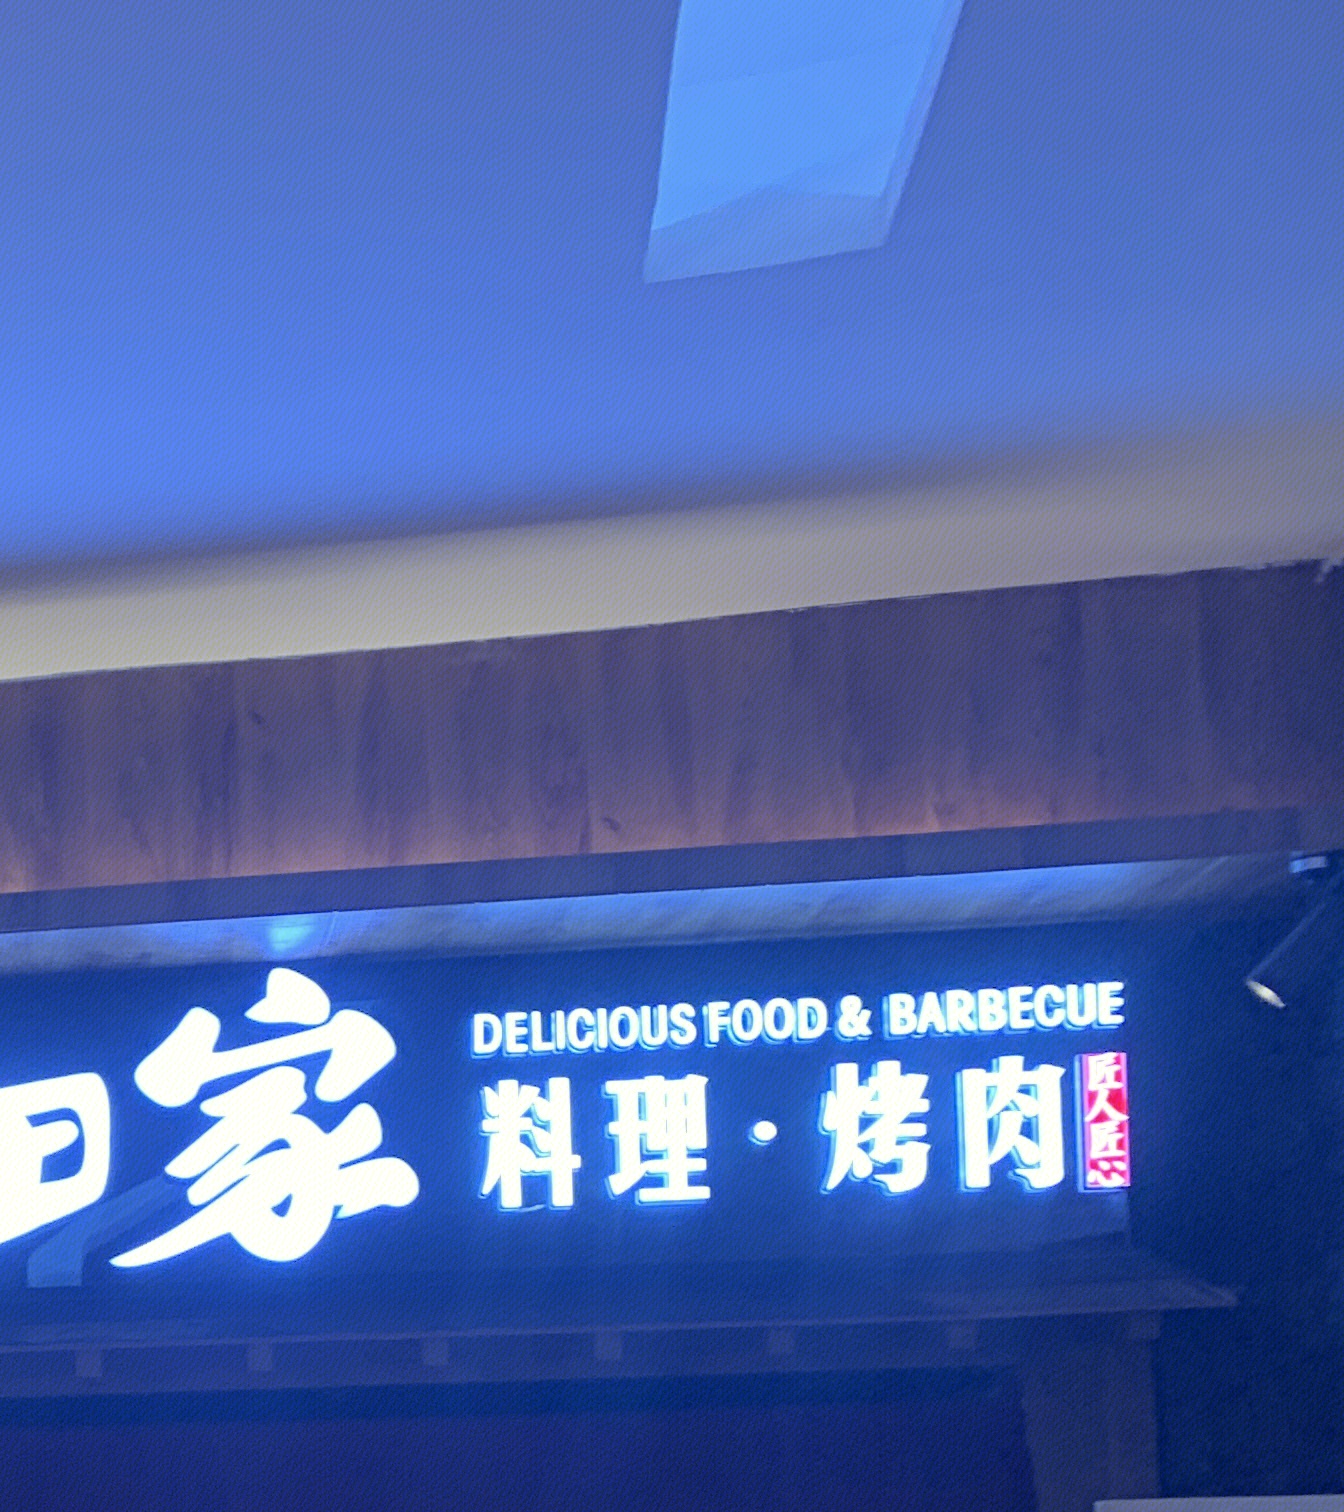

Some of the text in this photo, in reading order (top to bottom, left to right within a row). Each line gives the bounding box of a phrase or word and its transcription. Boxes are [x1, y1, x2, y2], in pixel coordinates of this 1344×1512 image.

[472, 981, 1125, 1056] DELICIOUS FOOD & BARBECUE
[1084, 1052, 1130, 1187] 匠人匠心
